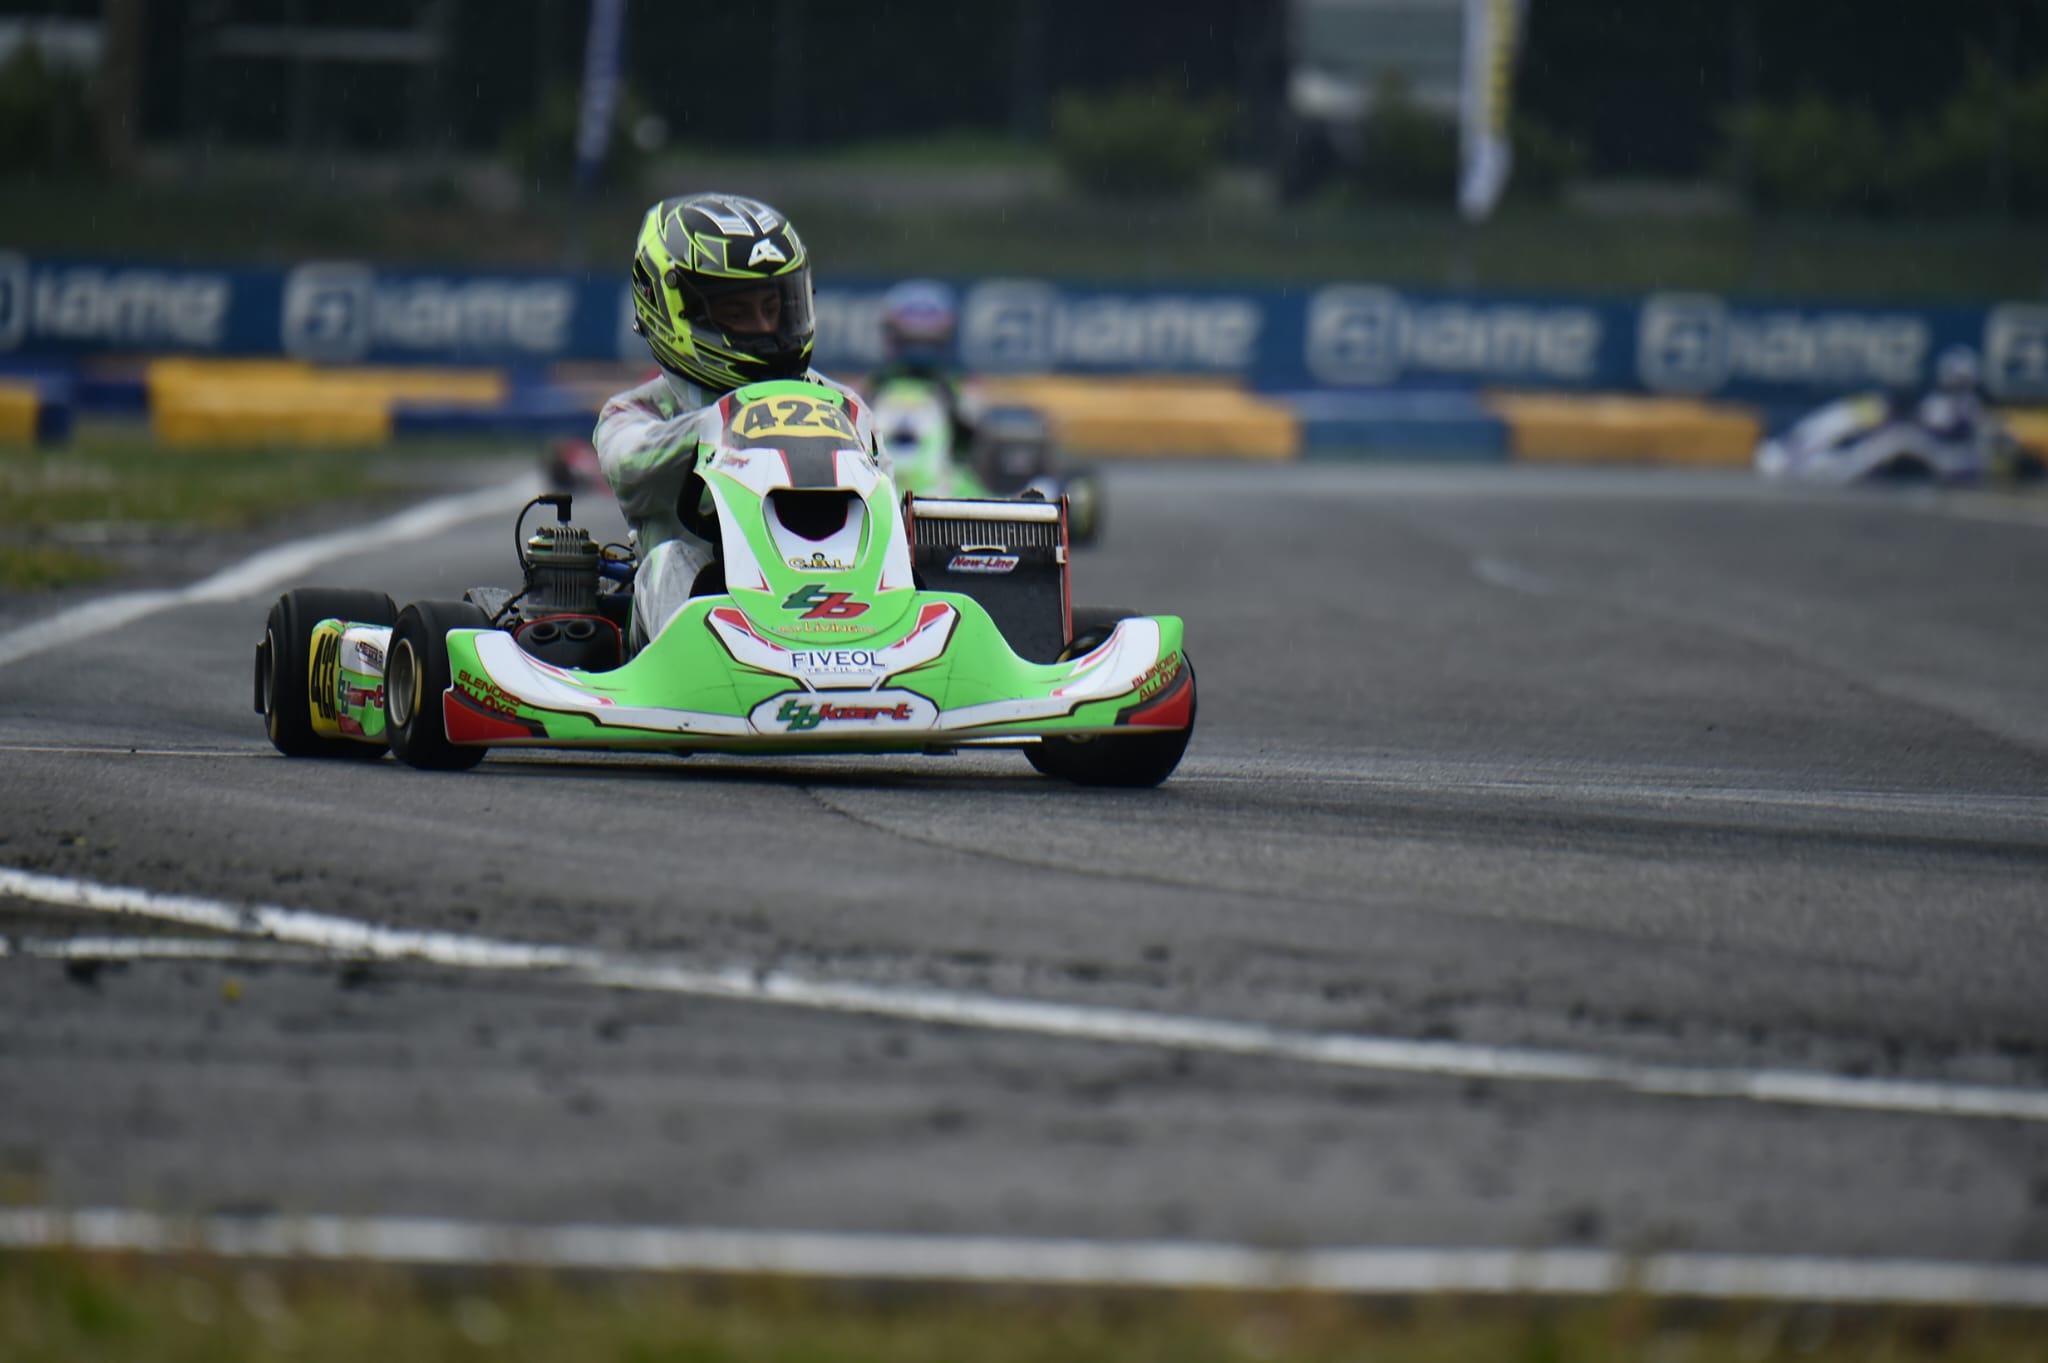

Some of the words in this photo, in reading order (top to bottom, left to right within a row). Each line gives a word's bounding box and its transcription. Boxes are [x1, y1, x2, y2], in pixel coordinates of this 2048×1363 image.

[743, 400, 851, 434] 423
[952, 555, 1015, 568] New-Line
[792, 651, 885, 667] FIVEOL
[1132, 650, 1178, 688] BLENDED
[455, 682, 518, 720] ALLOYS
[458, 669, 522, 707] BLENDED
[1140, 663, 1181, 703] ALLOYS
